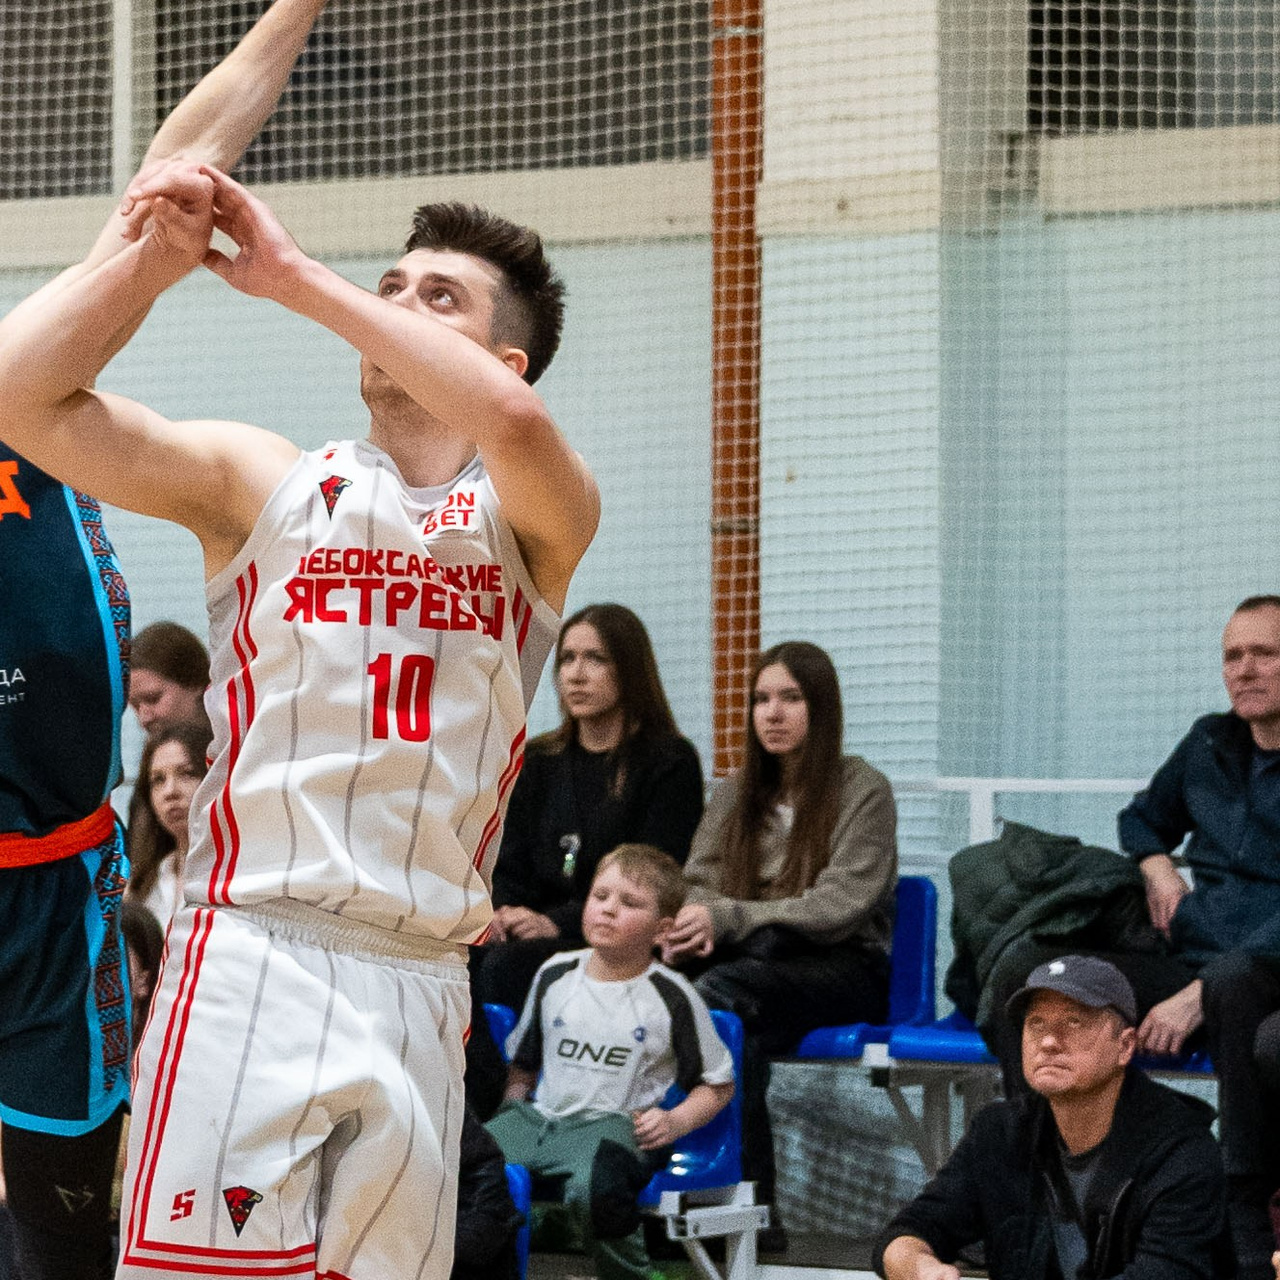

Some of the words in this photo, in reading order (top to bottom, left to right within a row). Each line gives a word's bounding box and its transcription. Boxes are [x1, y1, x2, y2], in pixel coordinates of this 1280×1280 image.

[298, 548, 503, 592] ЕБОКСАРКИЕ
[283, 577, 506, 641] ЯСТРЕБЫ
[367, 653, 435, 743] 10
[557, 1038, 632, 1067] ONE
